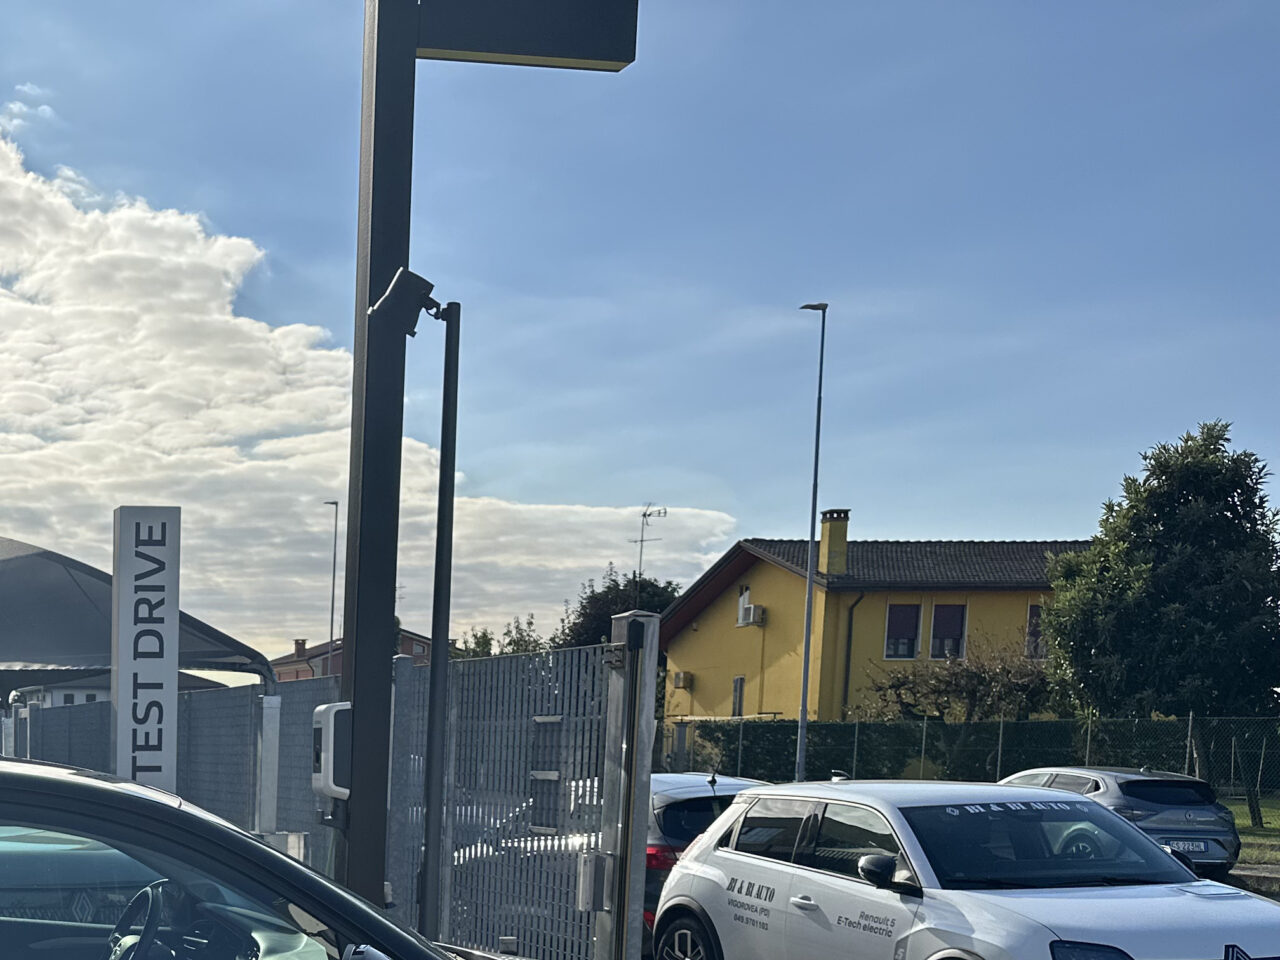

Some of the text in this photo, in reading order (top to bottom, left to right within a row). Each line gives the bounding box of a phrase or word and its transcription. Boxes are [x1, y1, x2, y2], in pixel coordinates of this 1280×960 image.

[131, 521, 167, 781] TEST DRIVE
[963, 802, 1071, 814] BI & BI AUTO
[726, 877, 776, 903] BI & BI AUTO
[836, 915, 893, 938] E-Tech electric
[859, 911, 897, 928] Renault 5
